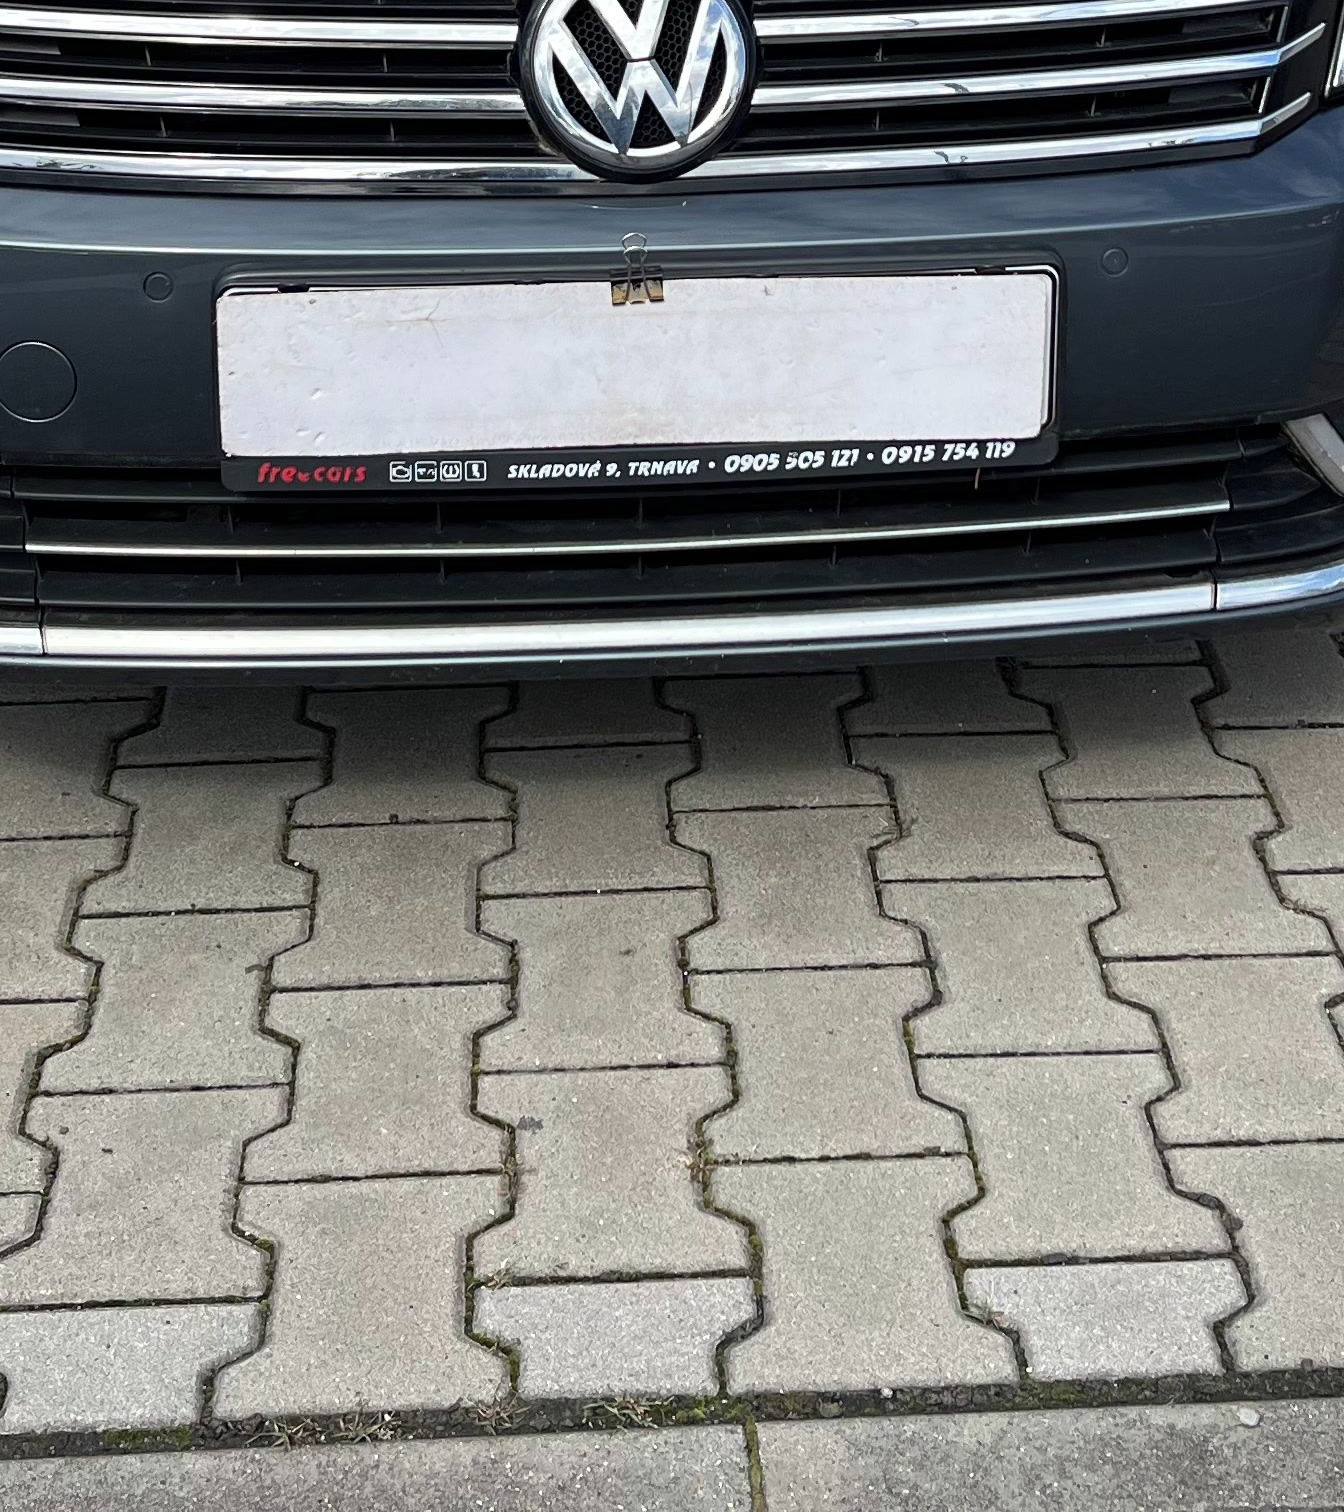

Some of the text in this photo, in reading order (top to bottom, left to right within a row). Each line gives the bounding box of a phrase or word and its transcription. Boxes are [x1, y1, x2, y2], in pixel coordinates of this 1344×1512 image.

[507, 460, 601, 479] SKLADOVÁ
[605, 463, 621, 478] 9,
[628, 459, 699, 477] TRNAVA
[724, 453, 779, 473] 0905
[785, 450, 825, 470] 505
[831, 448, 859, 467] 121
[881, 444, 936, 464] 0915
[941, 442, 979, 461] 754
[985, 441, 1016, 459] 119
